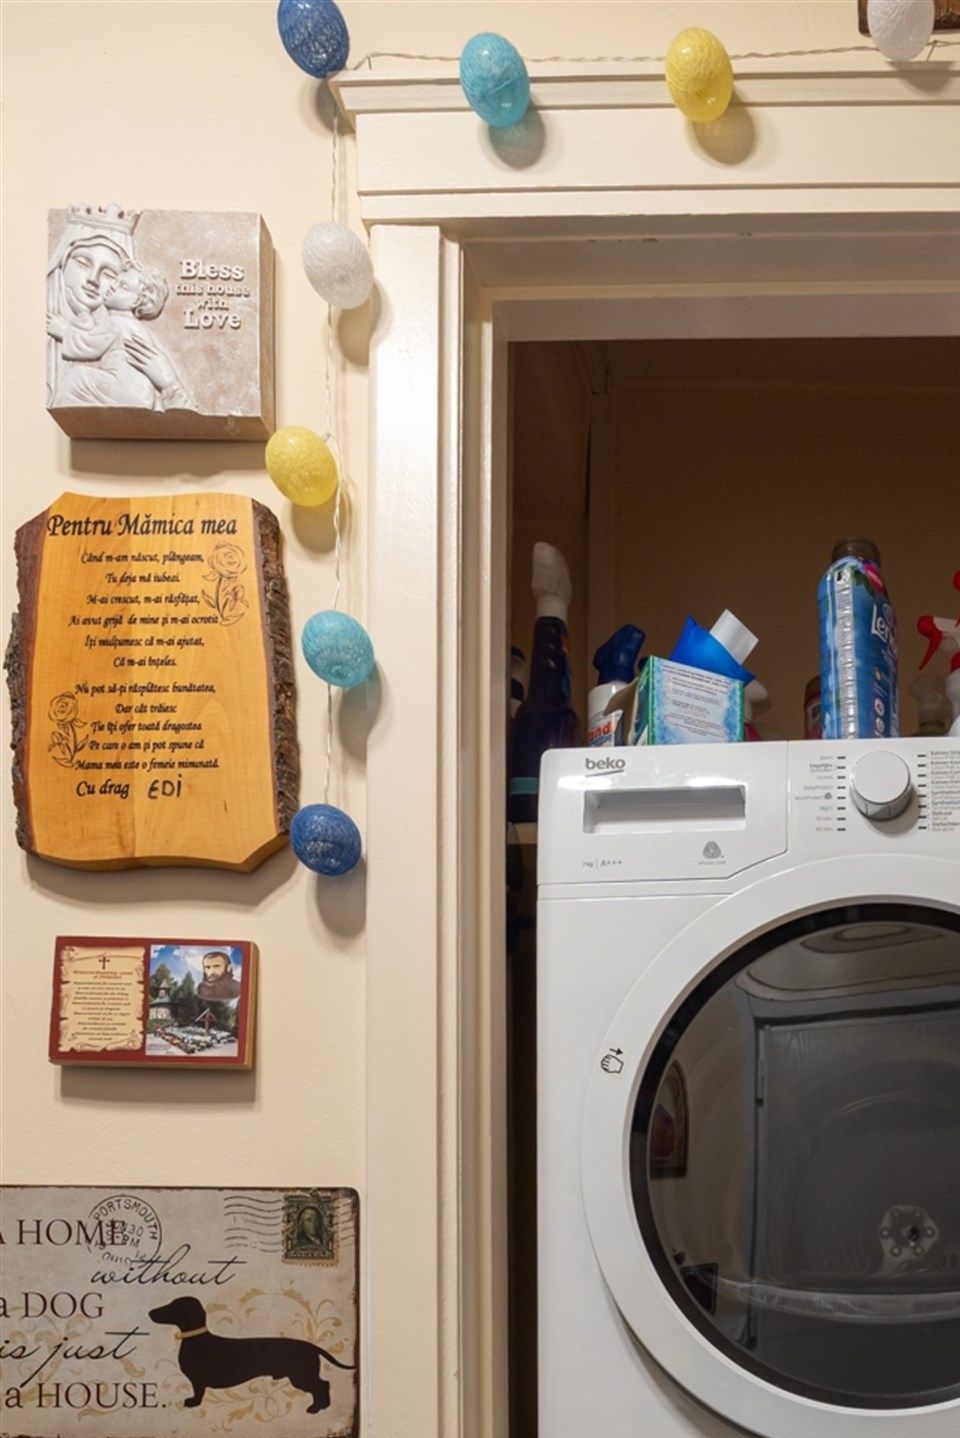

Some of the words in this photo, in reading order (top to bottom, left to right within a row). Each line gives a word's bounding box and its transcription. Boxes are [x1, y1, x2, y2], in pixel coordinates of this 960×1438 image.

[180, 259, 244, 281] Bless
[175, 284, 203, 296] this
[206, 285, 250, 298] house
[198, 299, 230, 311] with
[184, 309, 242, 330] Love
[47, 514, 112, 536] Pentru
[117, 513, 195, 536] Mămica
[200, 517, 238, 535] mea
[105, 572, 118, 583] Tu
[127, 614, 138, 624] de
[584, 757, 626, 772] beko
[76, 780, 97, 797] Cu
[99, 779, 131, 800] drag
[92, 1198, 158, 1241] PORTSMOUTH
[18, 1218, 127, 1246] HOME
[90, 1243, 248, 1286] without
[22, 1291, 105, 1319] DOG
[20, 1326, 150, 1388] just
[5, 1387, 23, 1409] a
[37, 1382, 167, 1409] HOUSE.
